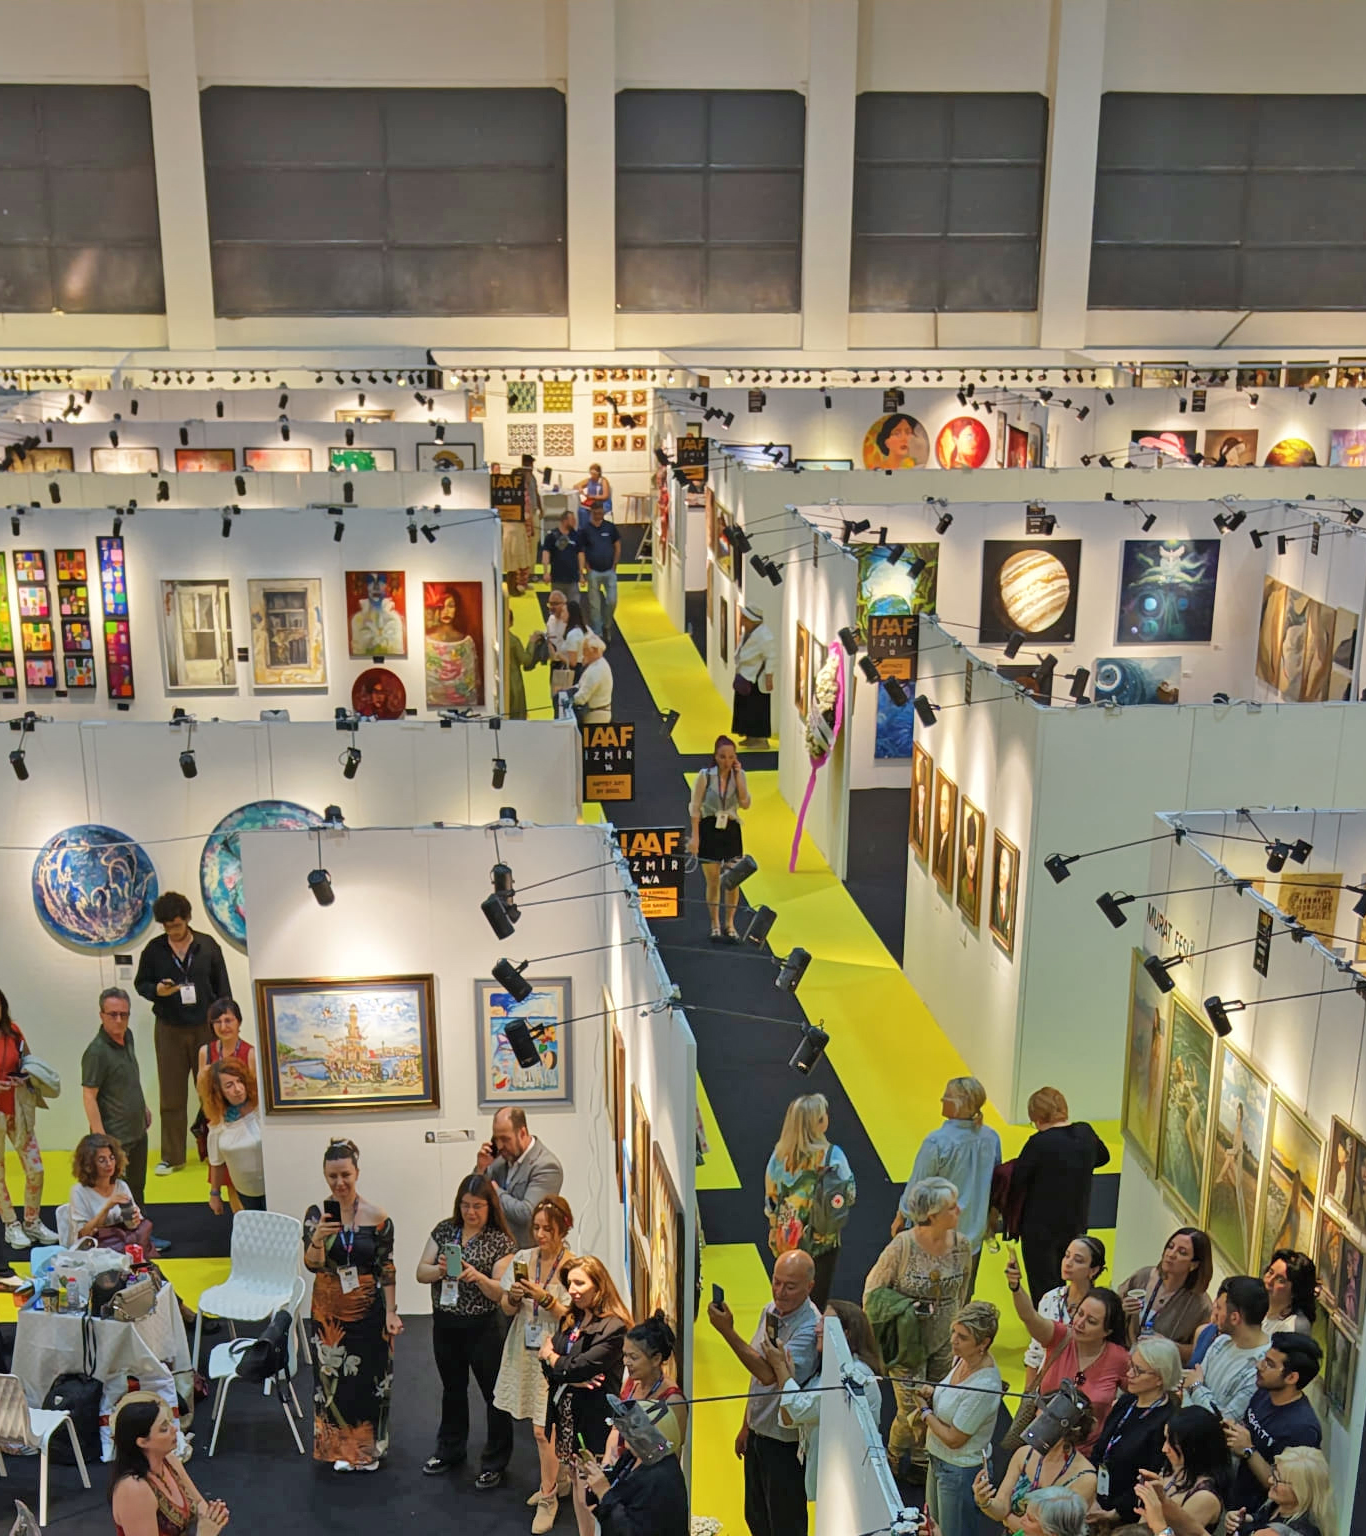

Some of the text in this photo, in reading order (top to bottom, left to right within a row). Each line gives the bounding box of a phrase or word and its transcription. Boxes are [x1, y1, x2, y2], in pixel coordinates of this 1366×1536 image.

[492, 475, 522, 488] IAAF
[872, 618, 914, 636] IAAF
[583, 726, 634, 748] IAAF
[620, 831, 680, 857] IAAF
[632, 857, 679, 872] ZMİR
